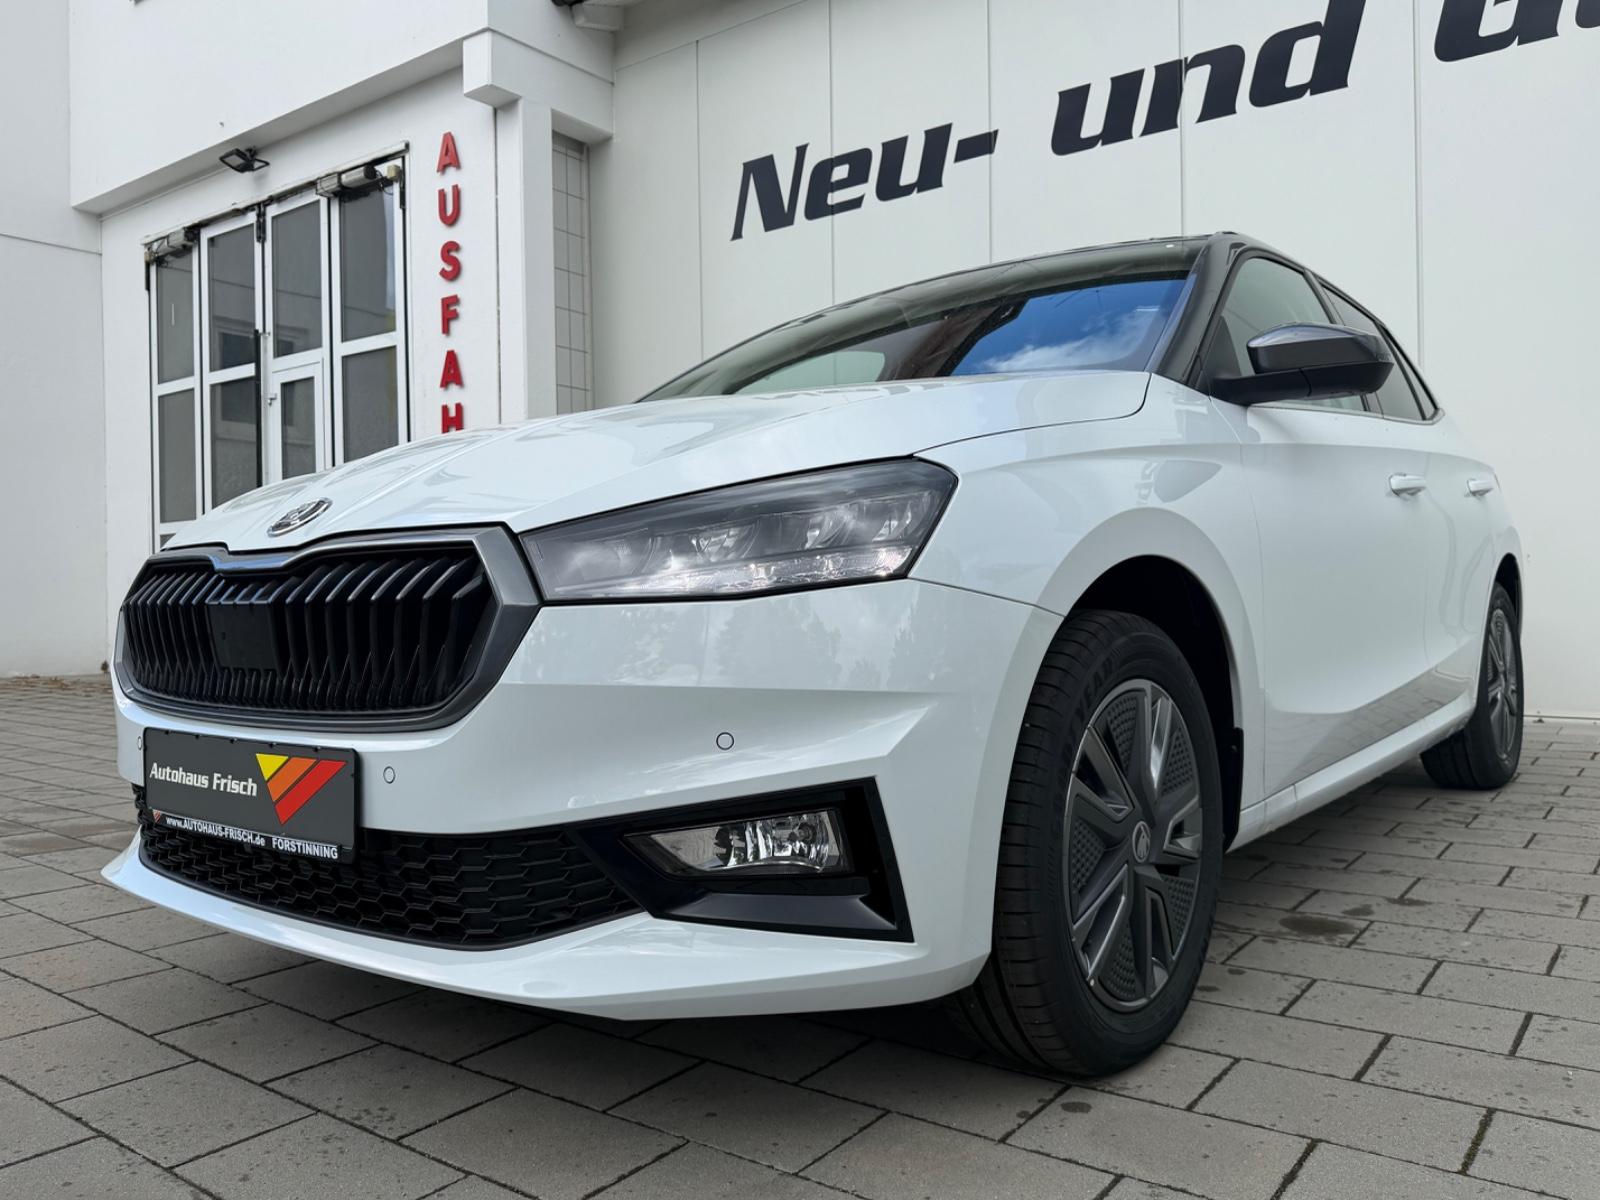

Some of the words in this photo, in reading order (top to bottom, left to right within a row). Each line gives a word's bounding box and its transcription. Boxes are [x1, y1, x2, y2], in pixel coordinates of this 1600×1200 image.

[731, 123, 999, 241] Neu-
[1051, 0, 1366, 156] und
[149, 761, 209, 790] Autohaus
[212, 772, 257, 797] Frisch
[165, 816, 266, 847] www.AUTOHAUS-FRISCH.de
[271, 837, 338, 860] FORSTINNING
